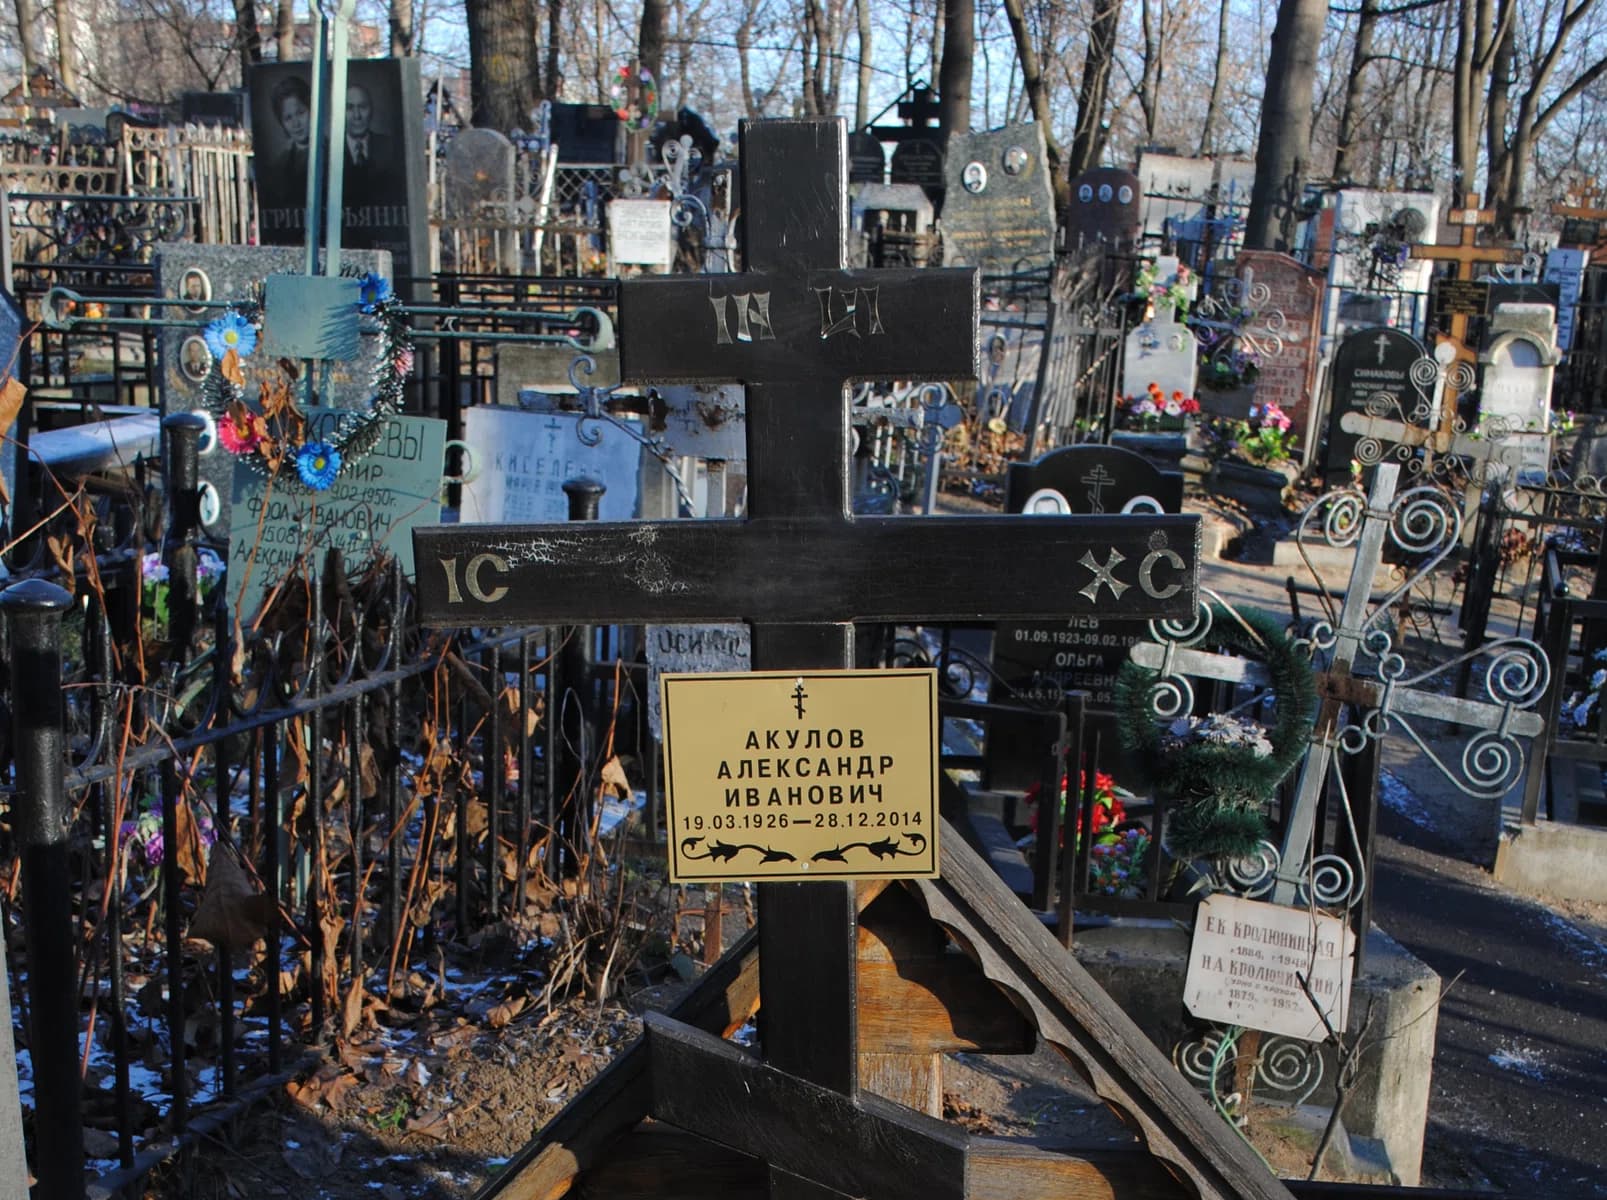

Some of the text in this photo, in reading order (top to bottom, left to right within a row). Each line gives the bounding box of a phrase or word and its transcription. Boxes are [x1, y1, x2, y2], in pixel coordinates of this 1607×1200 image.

[1015, 629, 1141, 648] 01.09.1923-09.02.19
[1056, 652, 1104, 667] ОЛЬГА
[1032, 670, 1116, 687] АНДРЕЕВН
[745, 729, 864, 750] АКУЛОВ
[717, 756, 894, 779] АЛЕКСАНДР
[725, 784, 883, 807] ИВАНОВИЧ
